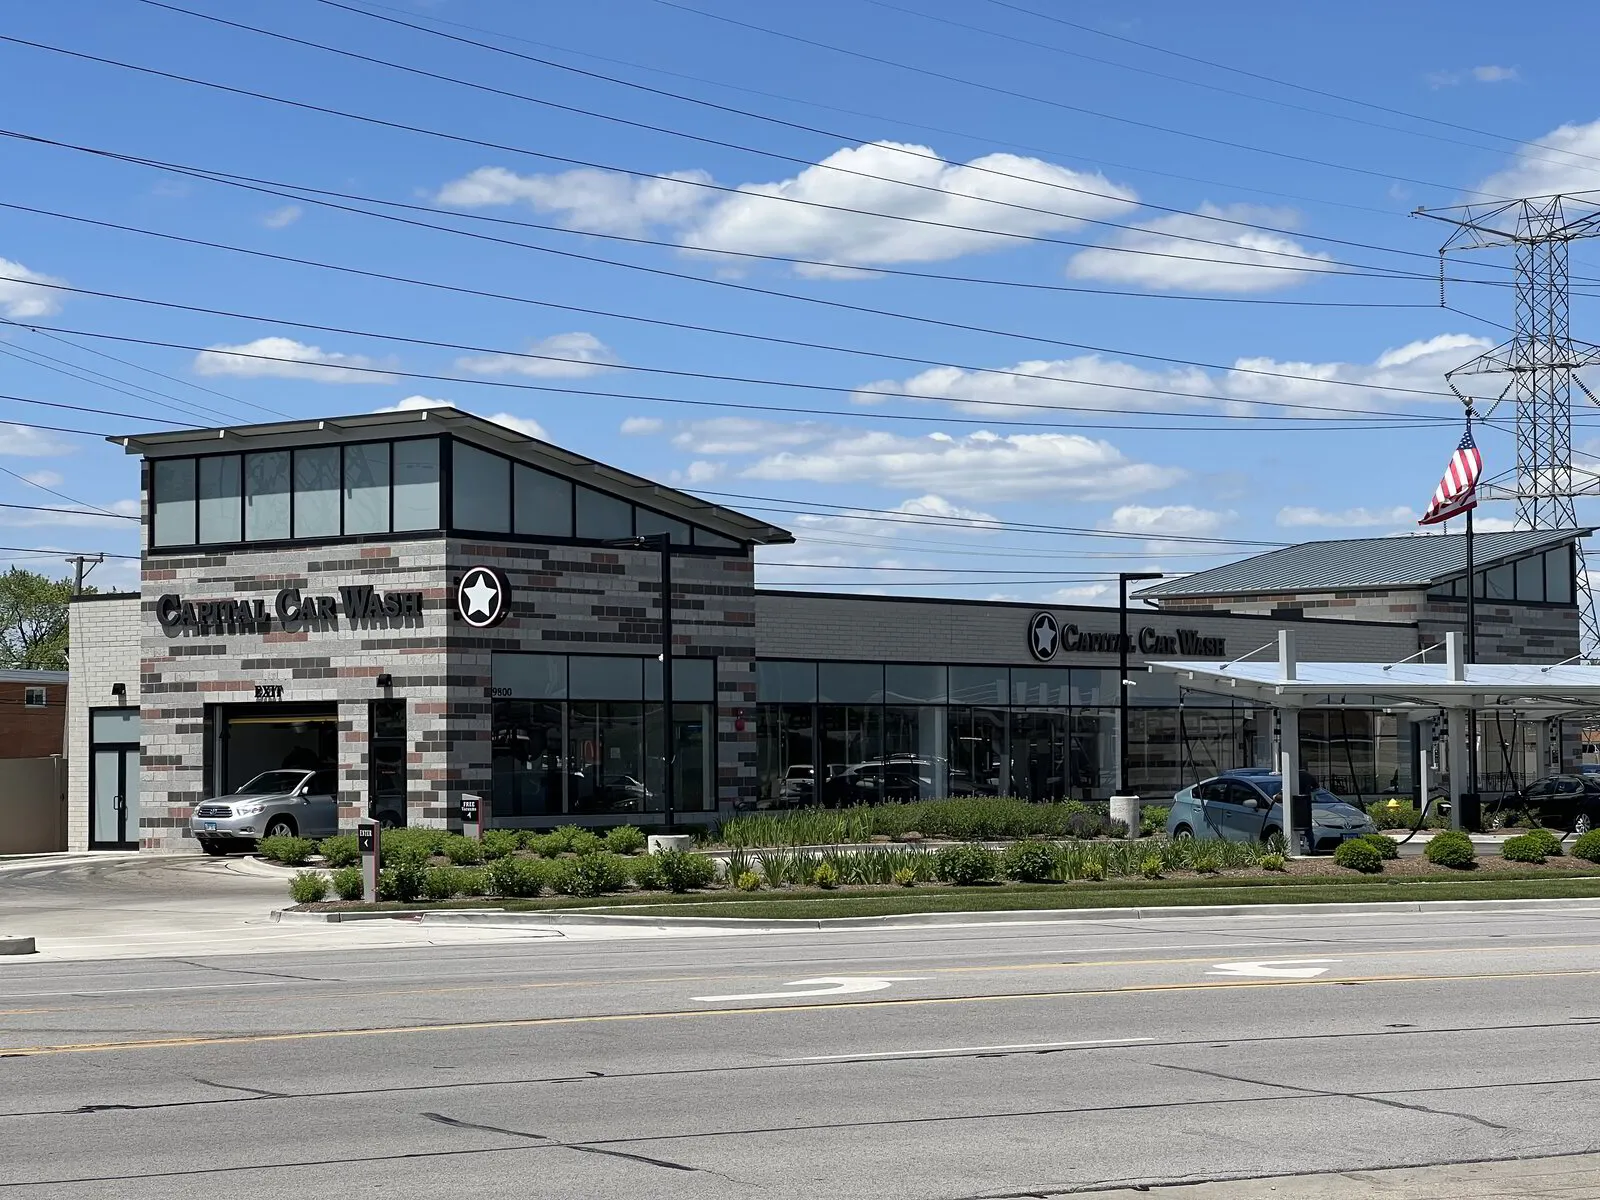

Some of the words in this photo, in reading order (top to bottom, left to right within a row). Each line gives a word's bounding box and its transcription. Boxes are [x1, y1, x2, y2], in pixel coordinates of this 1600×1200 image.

[157, 594, 271, 626] CAPITAL
[275, 588, 338, 621] CAR
[338, 585, 423, 618] WASH
[1061, 623, 1136, 653] CAPITL
[1139, 626, 1177, 655] CAR
[1177, 629, 1226, 656] WASH
[254, 685, 284, 698] EXIT
[492, 687, 512, 697] 9800
[359, 829, 373, 837] ENTER
